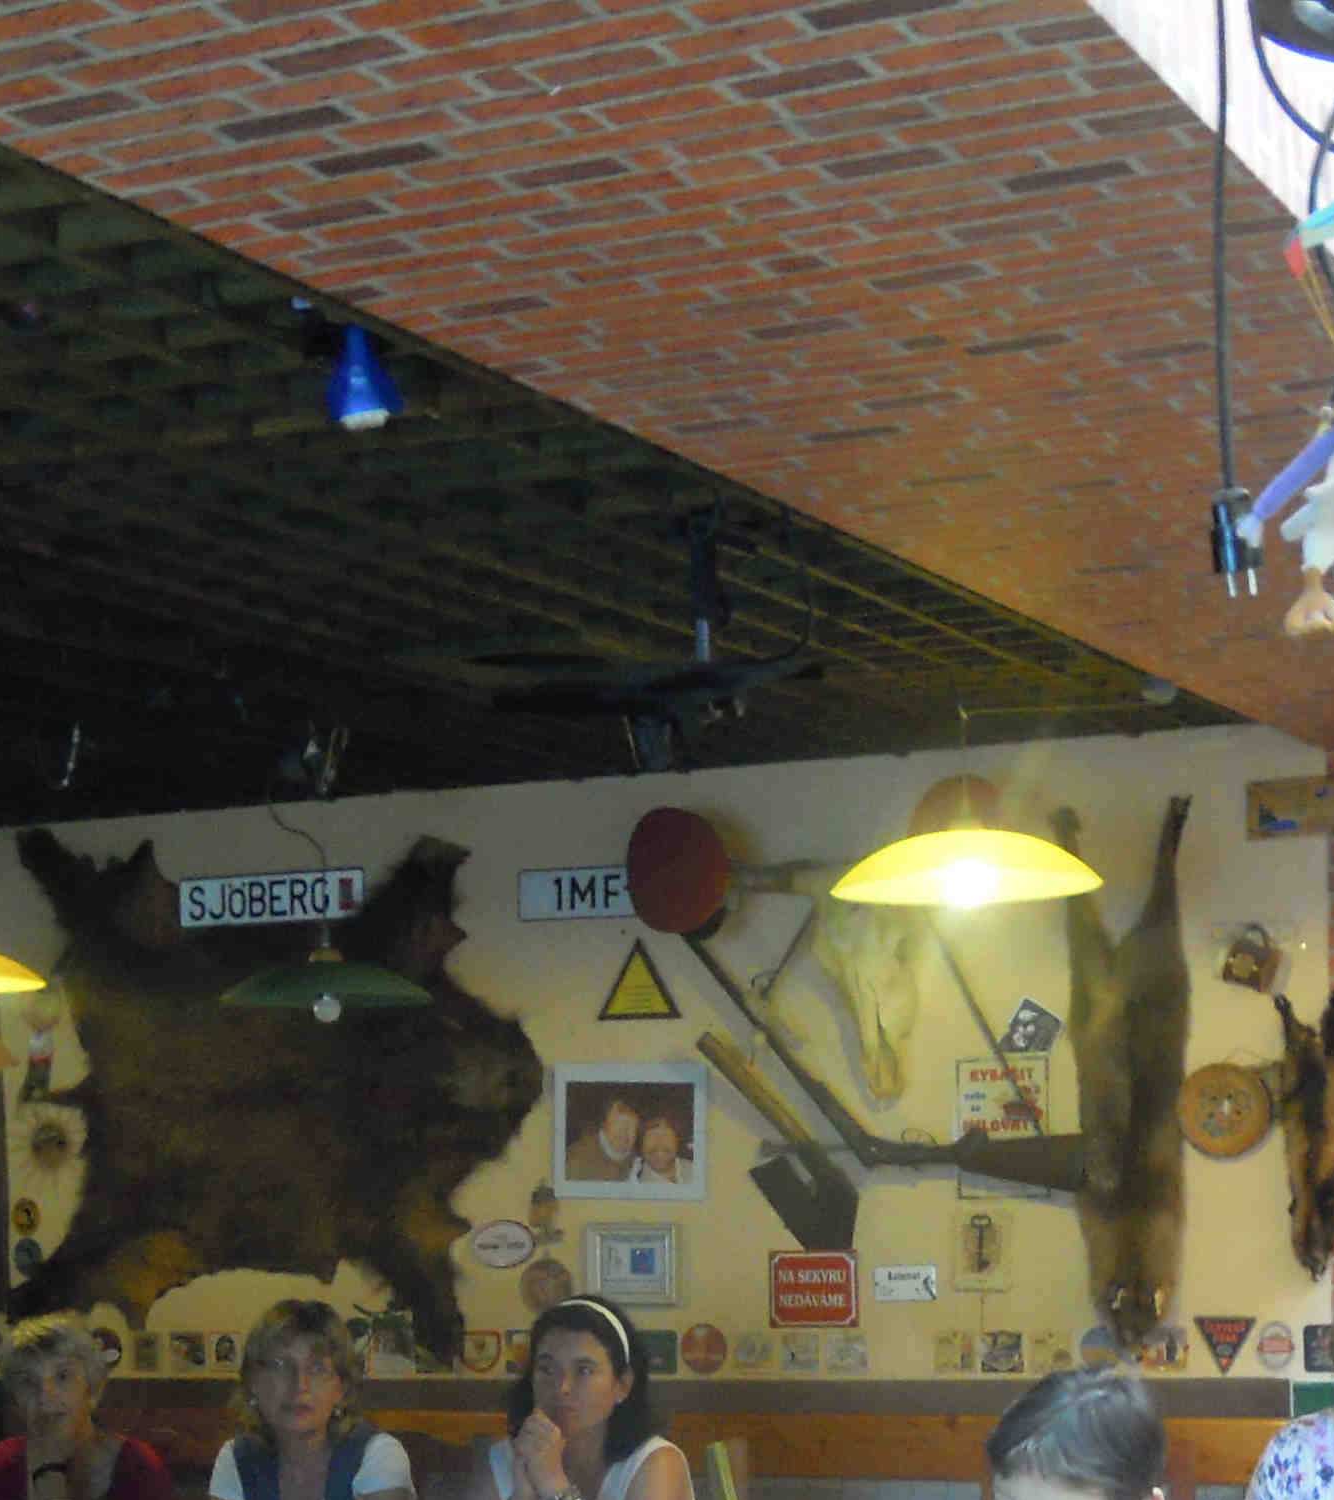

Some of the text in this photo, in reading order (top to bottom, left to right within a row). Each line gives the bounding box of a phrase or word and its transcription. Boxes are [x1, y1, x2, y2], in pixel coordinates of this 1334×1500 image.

[189, 876, 330, 921] SJÖBERG
[552, 872, 629, 911] 1MF
[779, 1270, 795, 1284] NA
